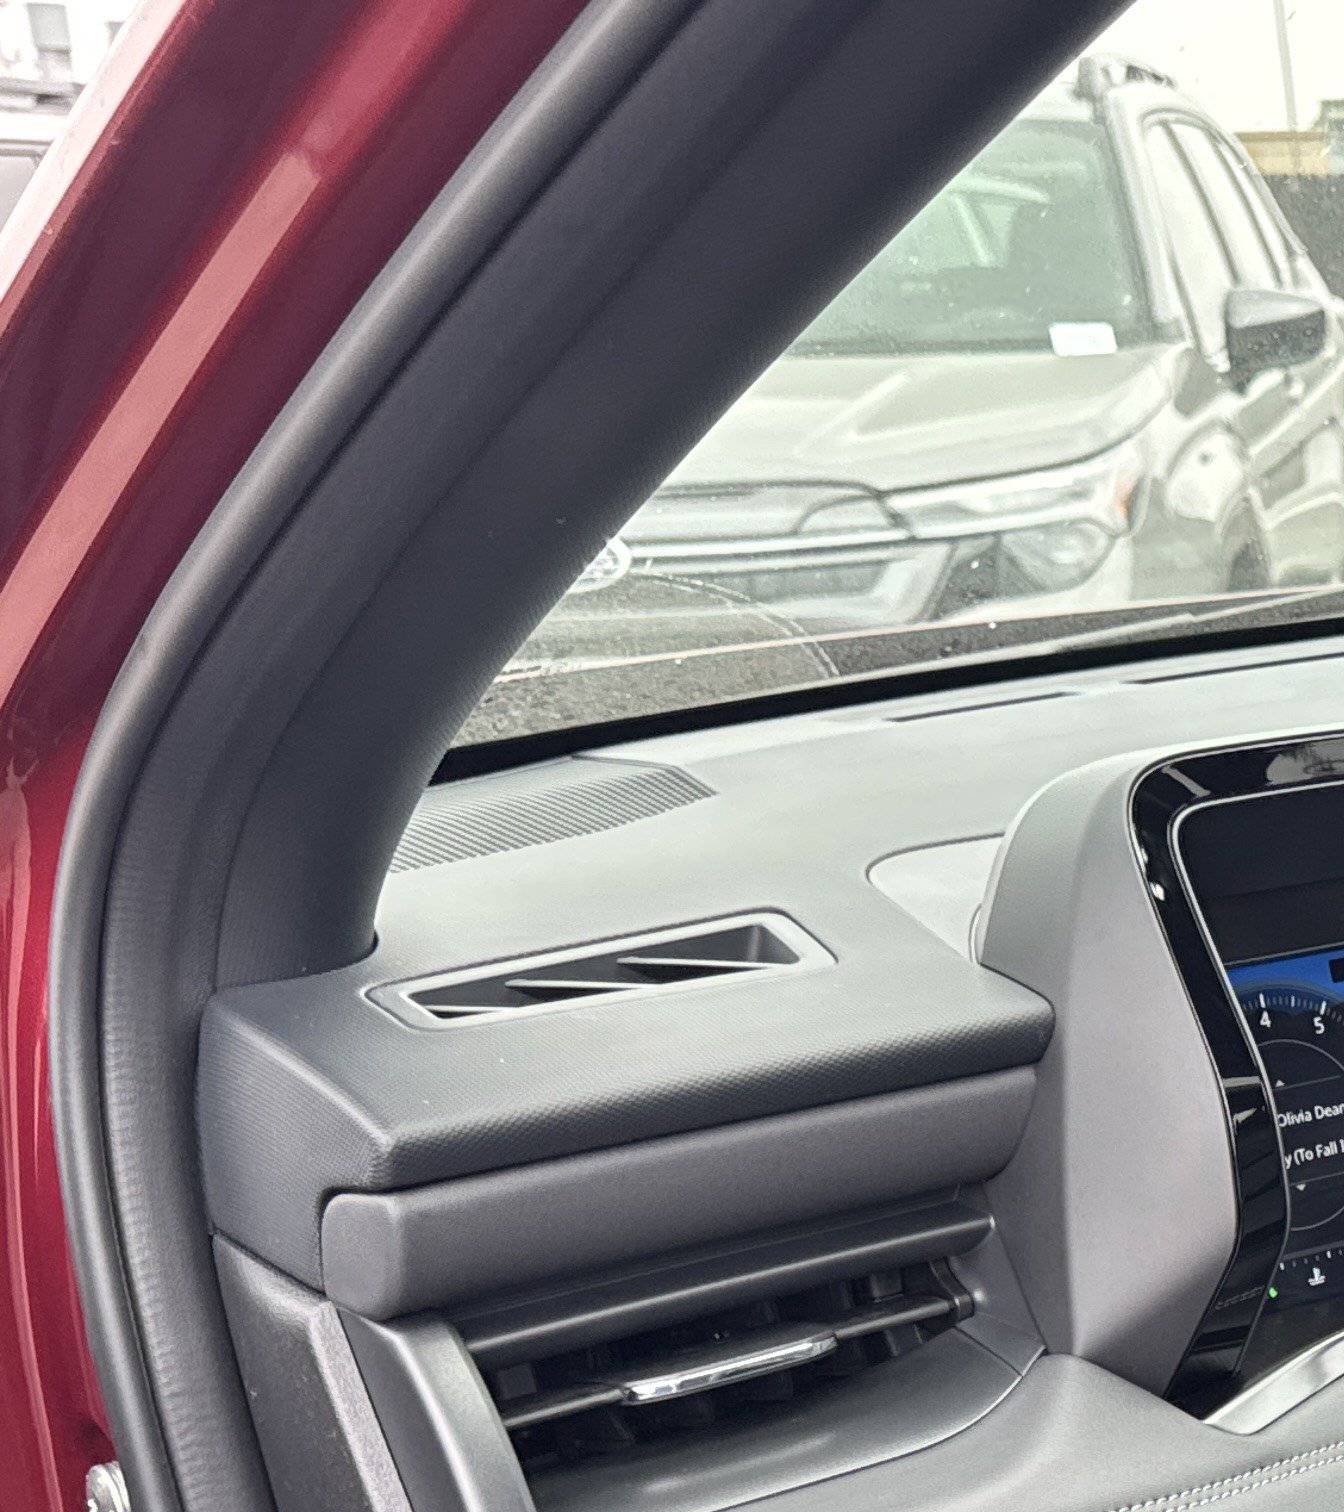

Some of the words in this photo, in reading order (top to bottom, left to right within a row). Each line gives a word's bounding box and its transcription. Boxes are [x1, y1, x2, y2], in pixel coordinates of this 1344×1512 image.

[1260, 1010, 1272, 1028] 4
[1313, 1016, 1326, 1035] 5
[1293, 1149, 1314, 1166] (To
[1315, 1140, 1338, 1159] Fall
